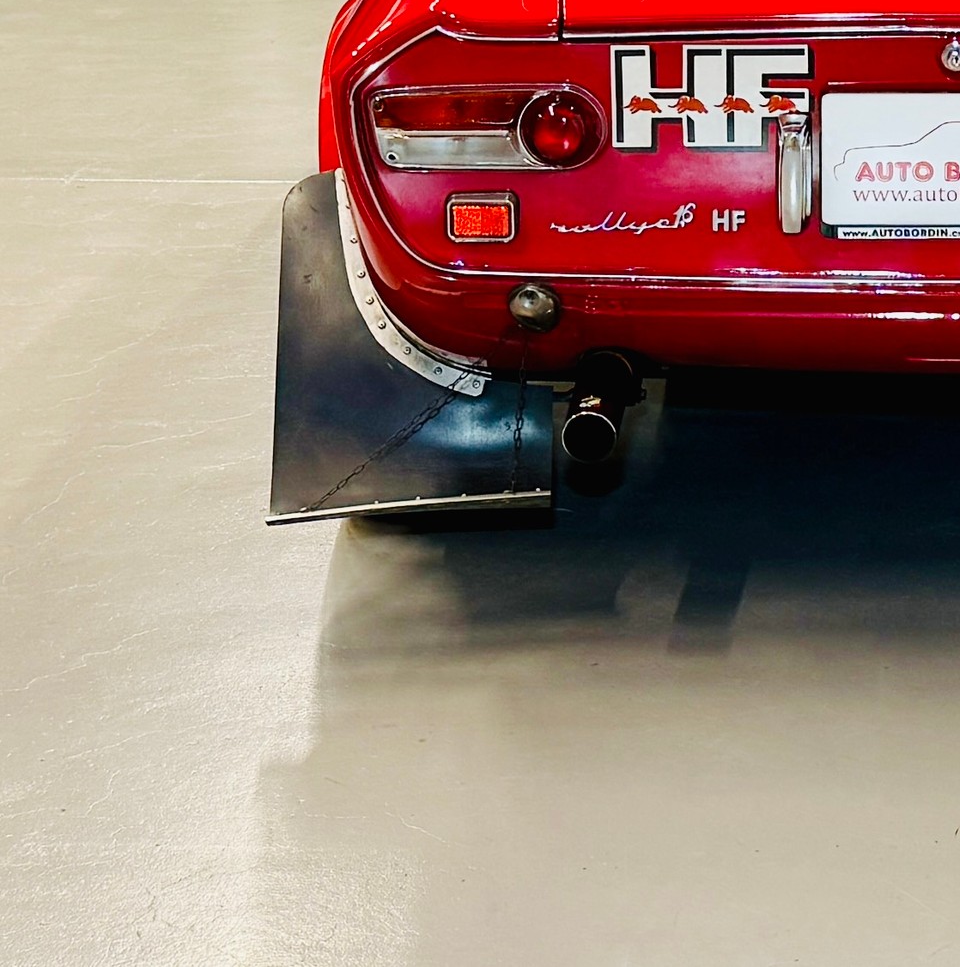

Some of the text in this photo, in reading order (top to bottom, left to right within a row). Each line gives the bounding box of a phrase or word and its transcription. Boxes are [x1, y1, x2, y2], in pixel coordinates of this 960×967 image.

[610, 44, 813, 151] HF
[854, 161, 934, 182] AUTO
[712, 208, 746, 232] HF
